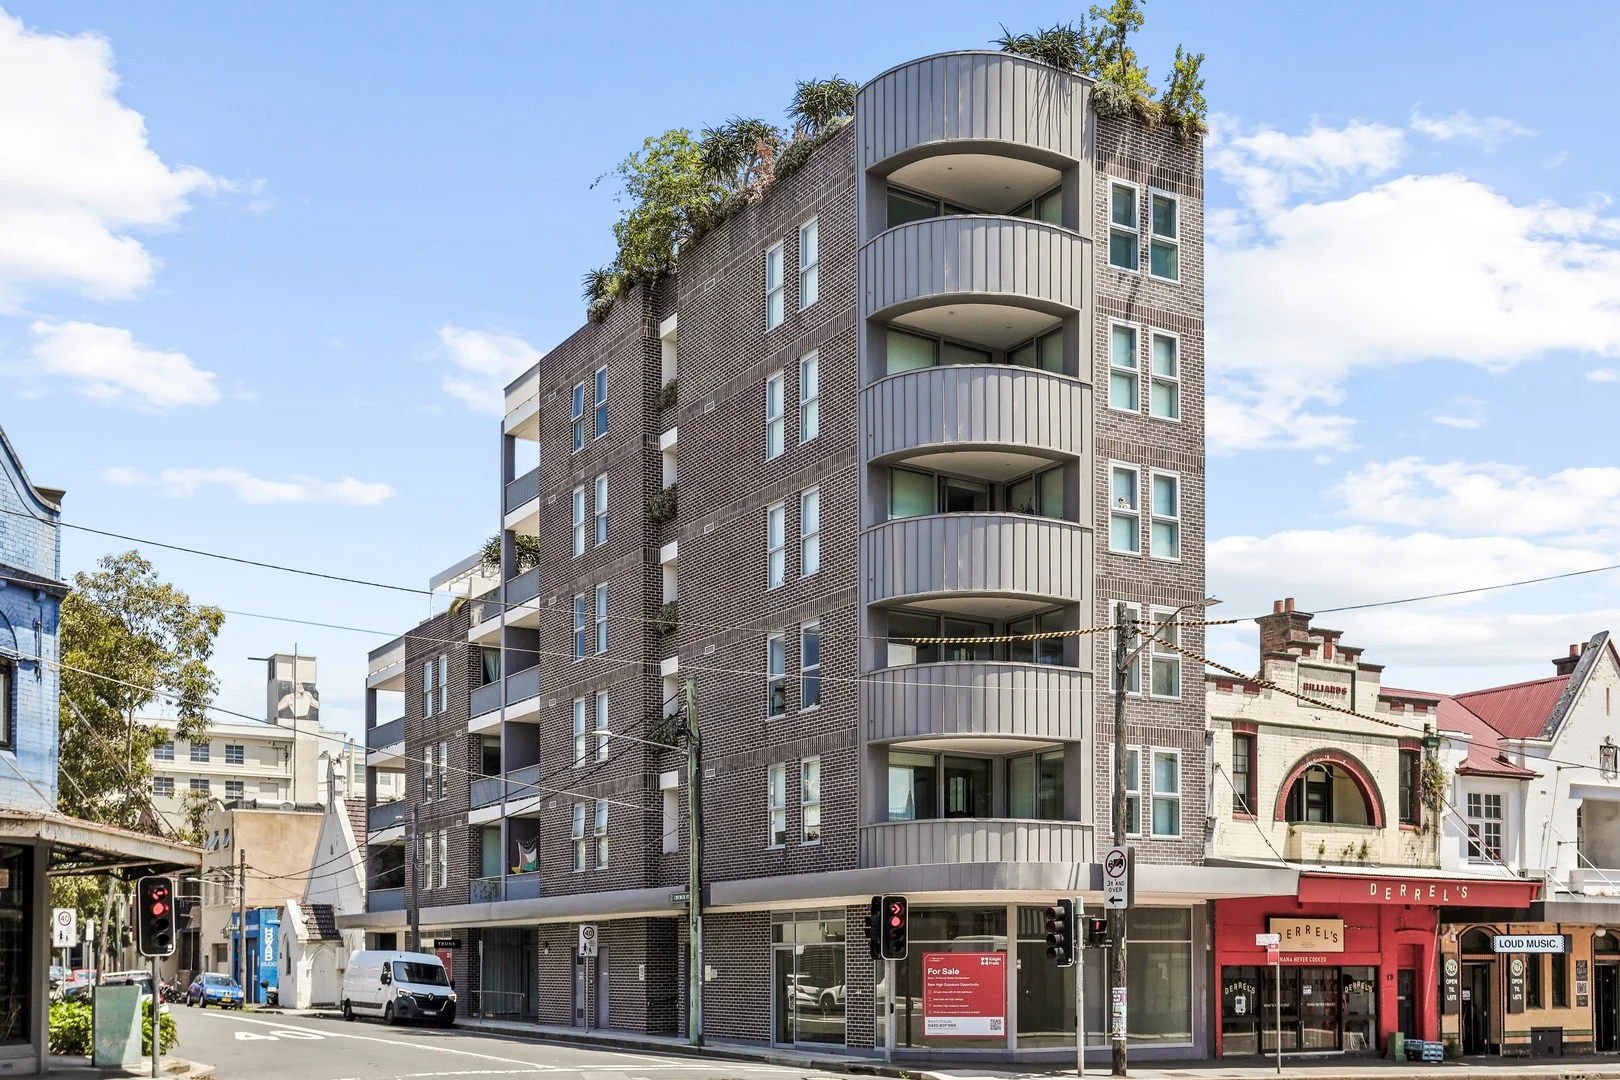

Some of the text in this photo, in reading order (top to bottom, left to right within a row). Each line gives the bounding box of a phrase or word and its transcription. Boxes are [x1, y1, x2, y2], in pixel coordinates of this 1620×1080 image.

[1303, 683, 1347, 695] BILLIARDS
[1370, 883, 1468, 902] DERREL'S
[1499, 939, 1559, 948] LOUD MUSIC.
[1224, 982, 1256, 995] DERREL'S
[1344, 981, 1373, 993] DERREL'S
[235, 1030, 325, 1041] 40
